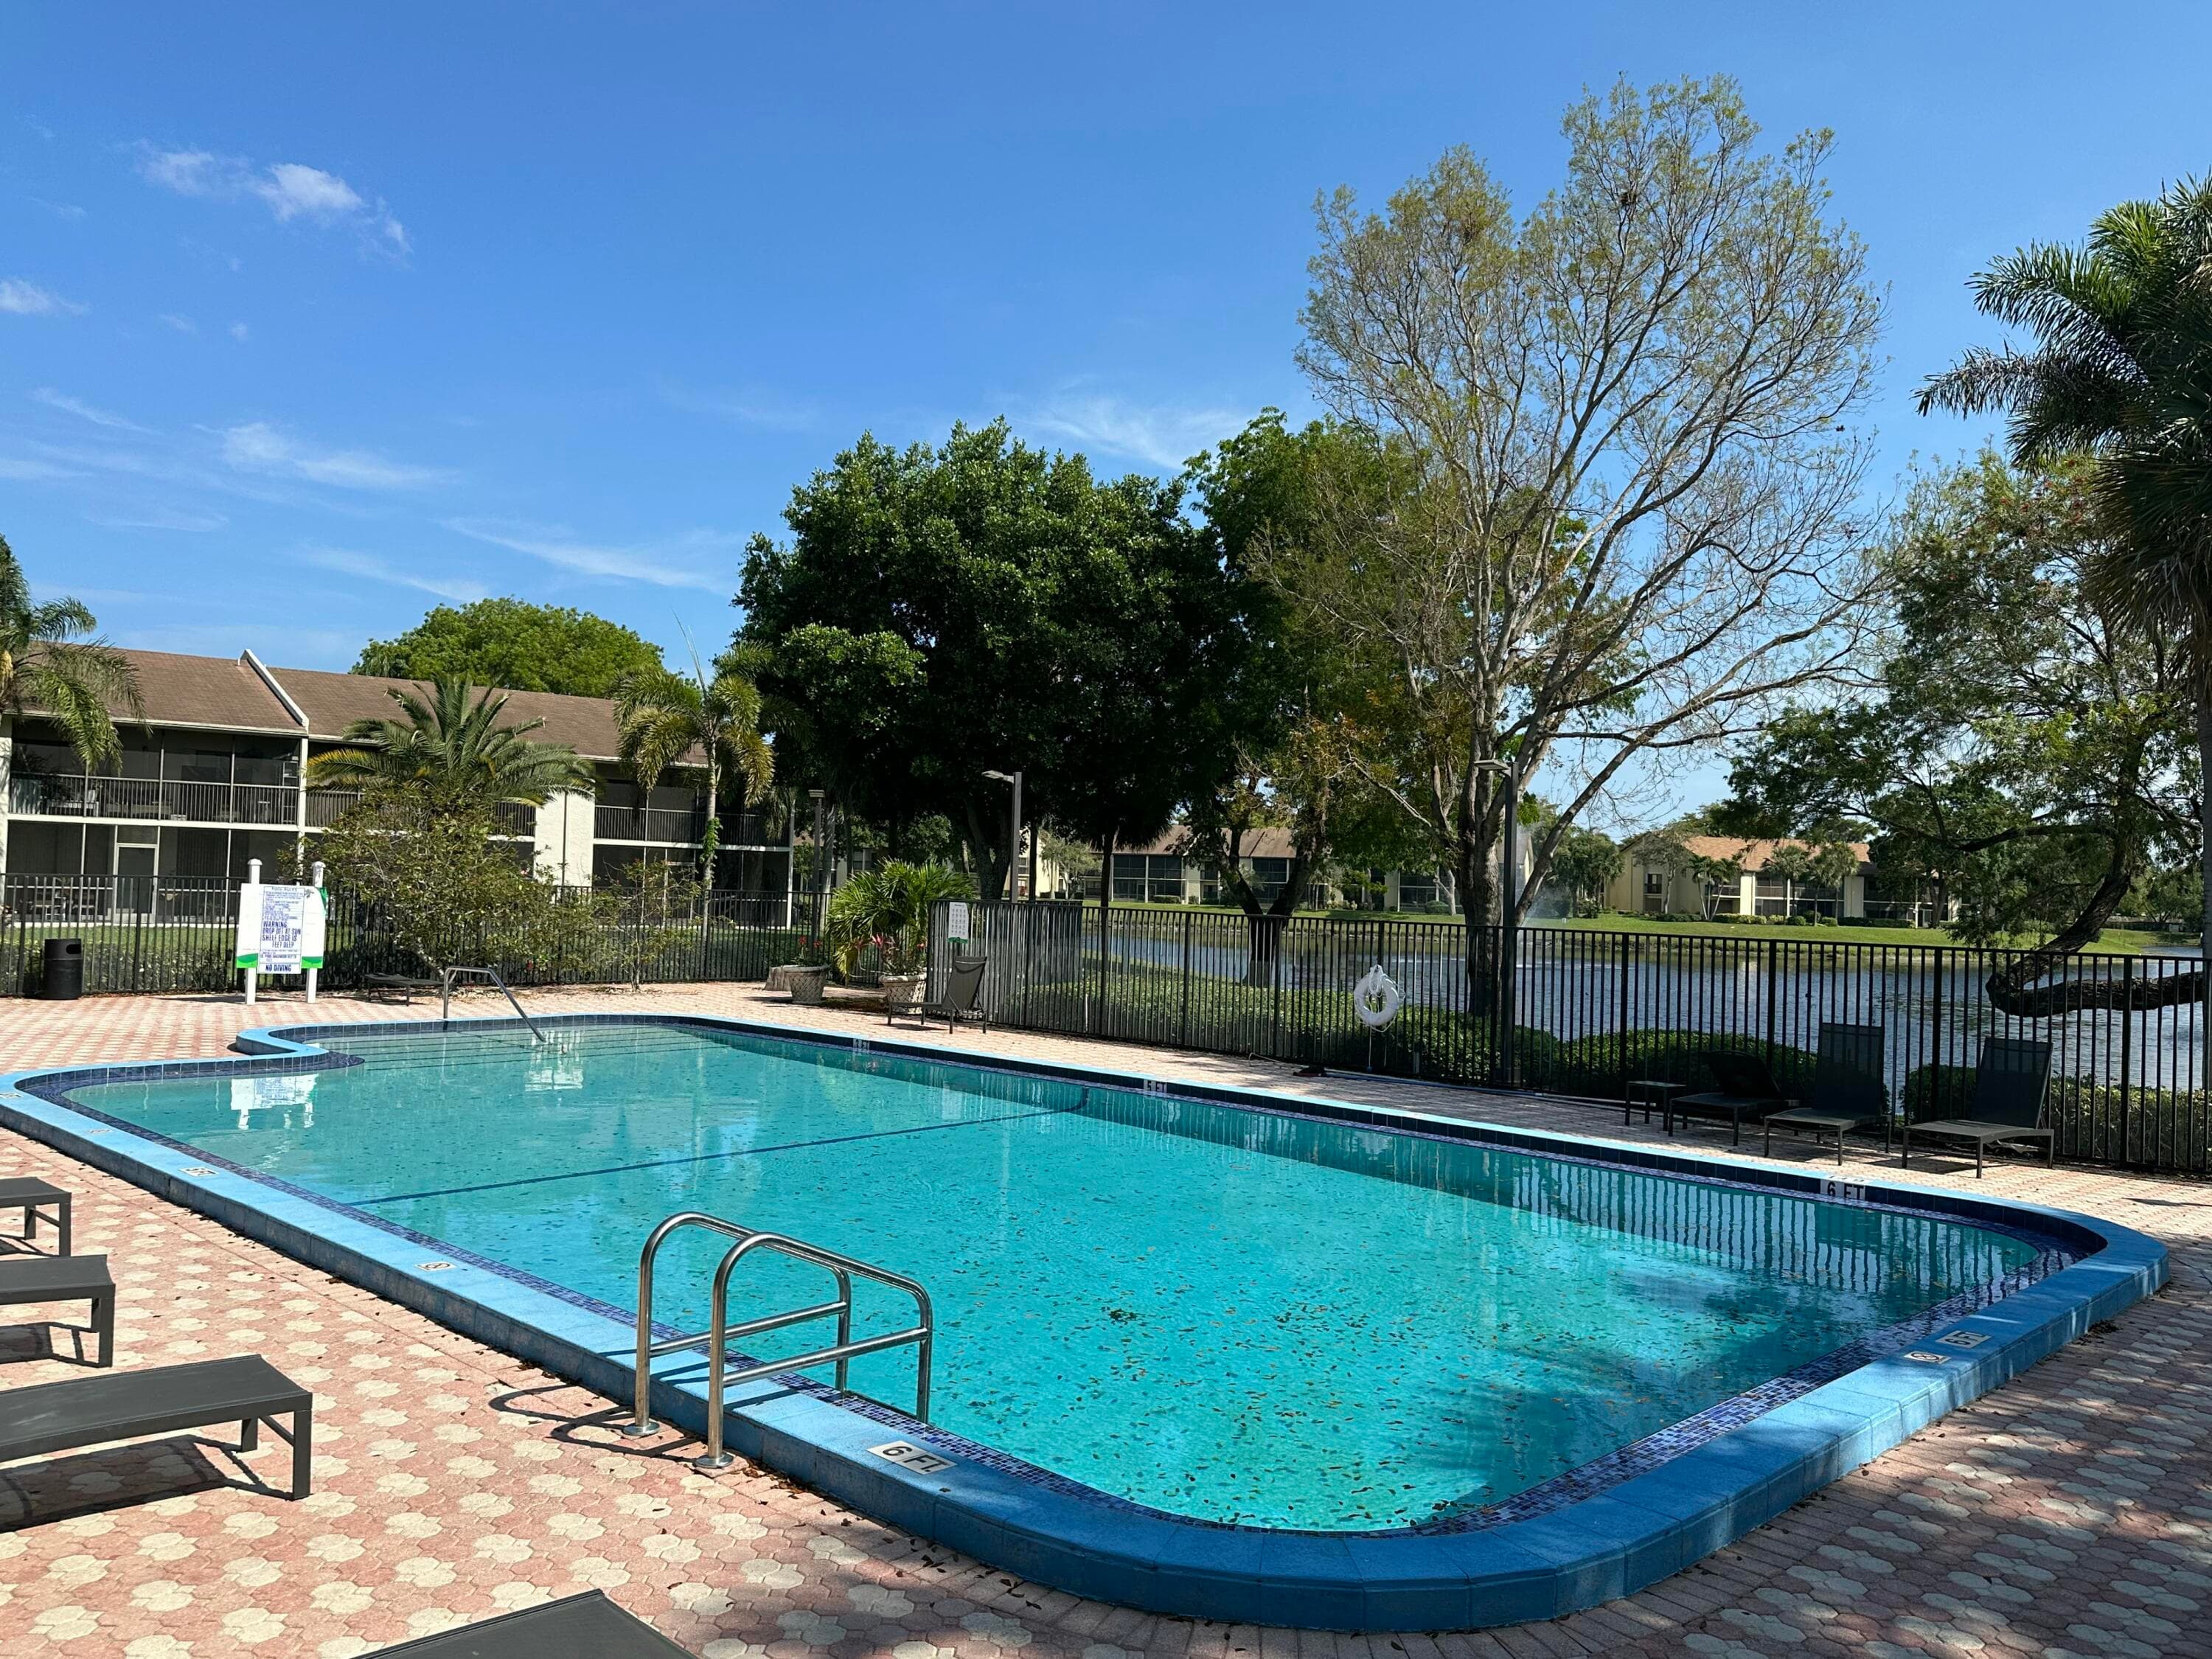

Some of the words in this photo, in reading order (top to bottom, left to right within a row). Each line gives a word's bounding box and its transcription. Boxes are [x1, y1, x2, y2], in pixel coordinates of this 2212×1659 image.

[265, 964, 273, 972] NO
[274, 964, 292, 973] DIVING
[1828, 1181, 1836, 1197] 6
[1844, 1183, 1864, 1200] FT
[883, 1446, 913, 1456] 6
